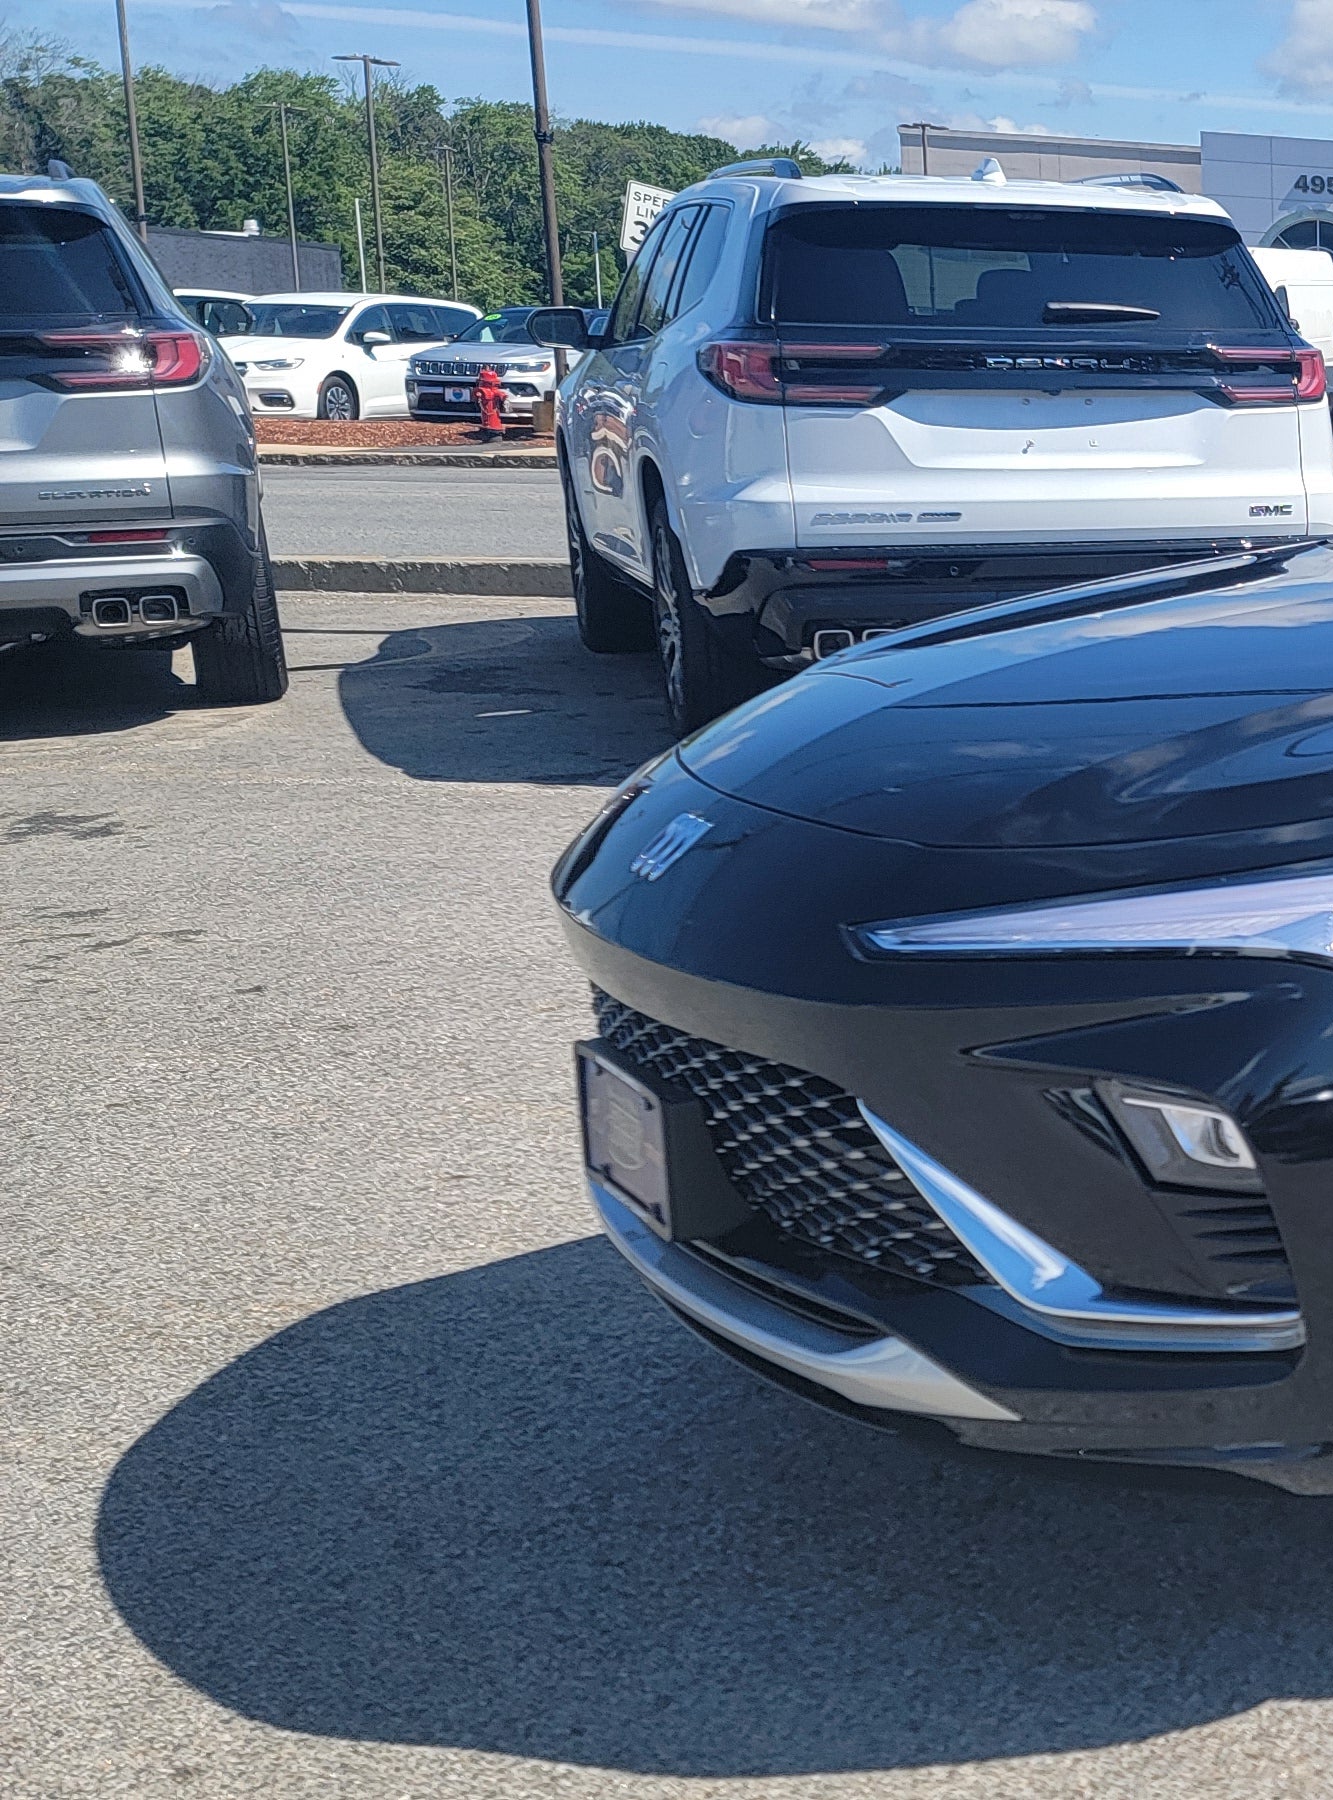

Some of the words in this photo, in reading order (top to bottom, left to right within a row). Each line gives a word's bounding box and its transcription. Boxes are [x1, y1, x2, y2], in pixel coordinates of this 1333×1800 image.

[633, 191, 671, 208] SPEE
[629, 220, 650, 245] 3
[1249, 504, 1293, 517] GMC
